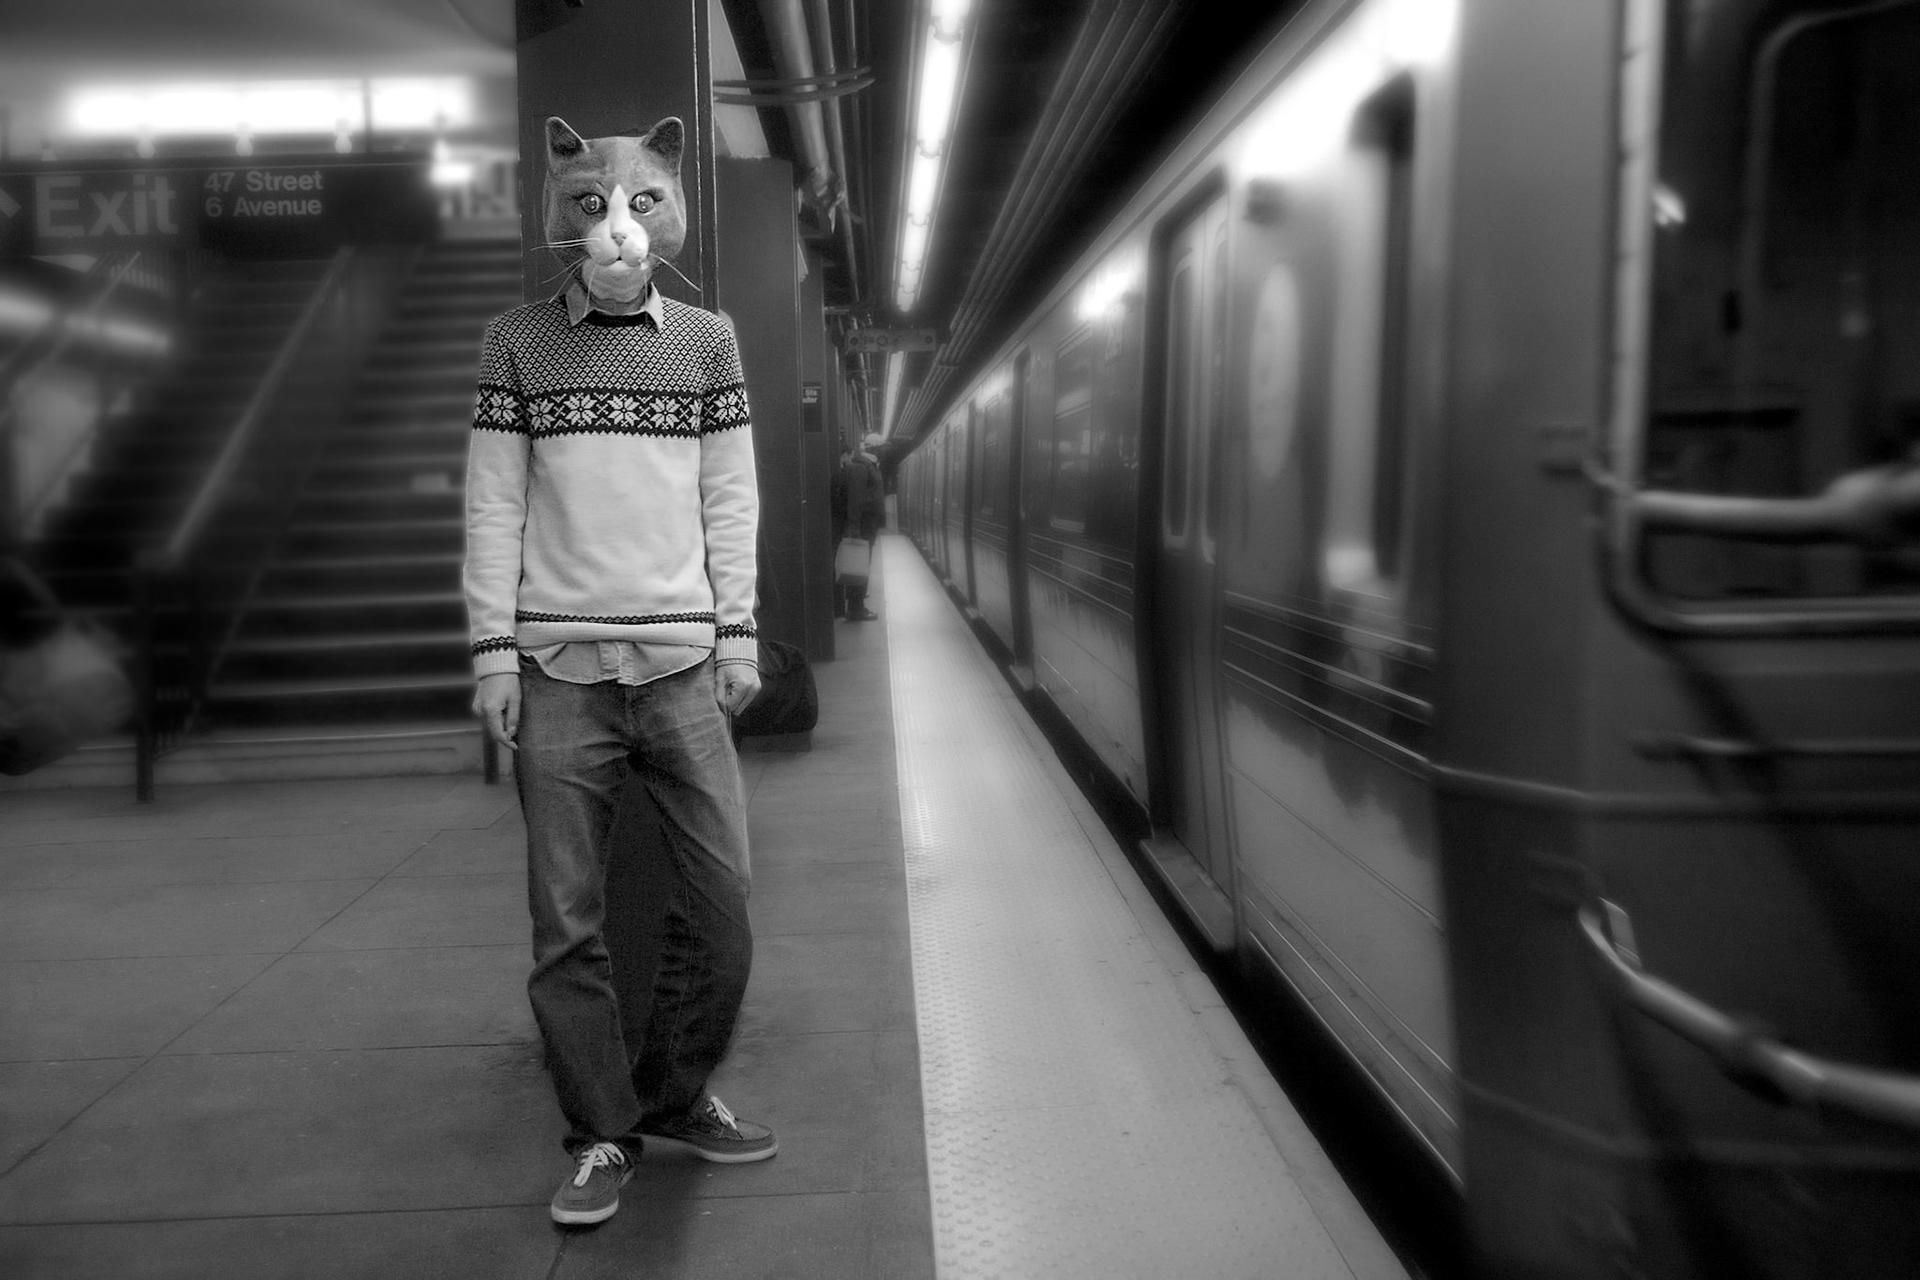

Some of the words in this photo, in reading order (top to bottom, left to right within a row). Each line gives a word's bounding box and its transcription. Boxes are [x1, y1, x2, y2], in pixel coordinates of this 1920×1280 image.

[204, 171, 235, 192] 47
[246, 170, 323, 192] Street
[35, 173, 178, 238] Exit
[205, 196, 223, 217] 6
[233, 196, 322, 217] Avenue
